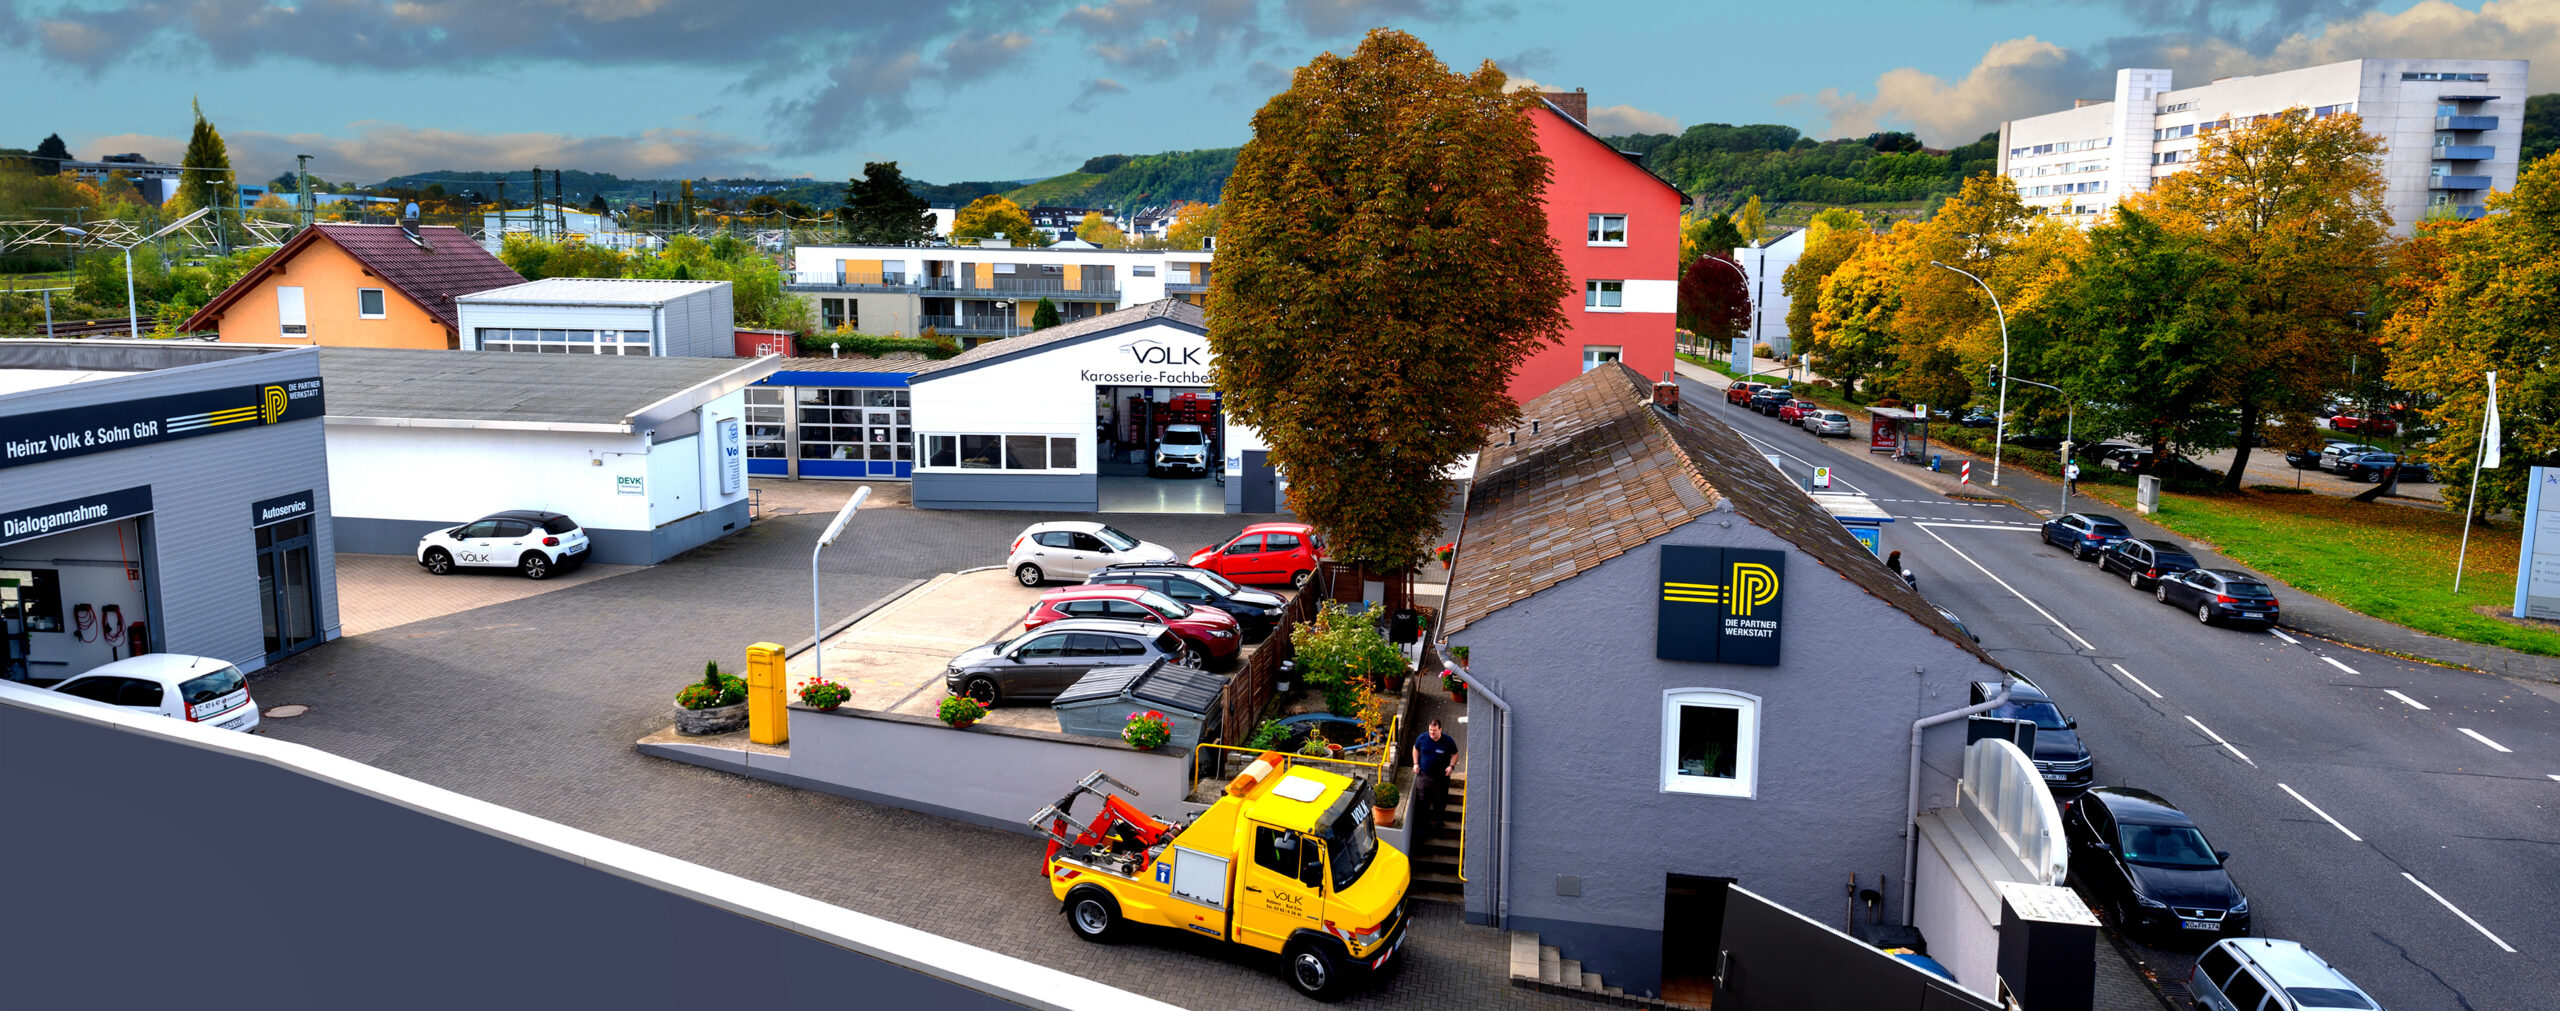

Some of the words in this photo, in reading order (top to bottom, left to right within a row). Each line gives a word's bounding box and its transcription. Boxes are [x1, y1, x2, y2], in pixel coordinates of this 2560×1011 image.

[1132, 346, 1201, 365] VOLK
[288, 383, 297, 391] DIE
[297, 380, 320, 390] PARTNER
[289, 389, 318, 399] WERKSTATT
[6, 439, 48, 459] Heinz
[50, 432, 82, 451] Volk
[84, 430, 95, 446] &
[97, 426, 130, 444] Sohn
[133, 420, 159, 438] GbR
[618, 476, 642, 485] DEVK
[262, 500, 307, 520] Autoservice
[4, 502, 109, 537] Dialogannahme
[460, 553, 490, 563] VOLK
[1725, 619, 1739, 627] DIE
[1740, 620, 1777, 629] PARTNER
[1725, 628, 1773, 638] WERKSTATT
[1351, 799, 1370, 825] VOLK
[1273, 889, 1303, 906] VOLK
